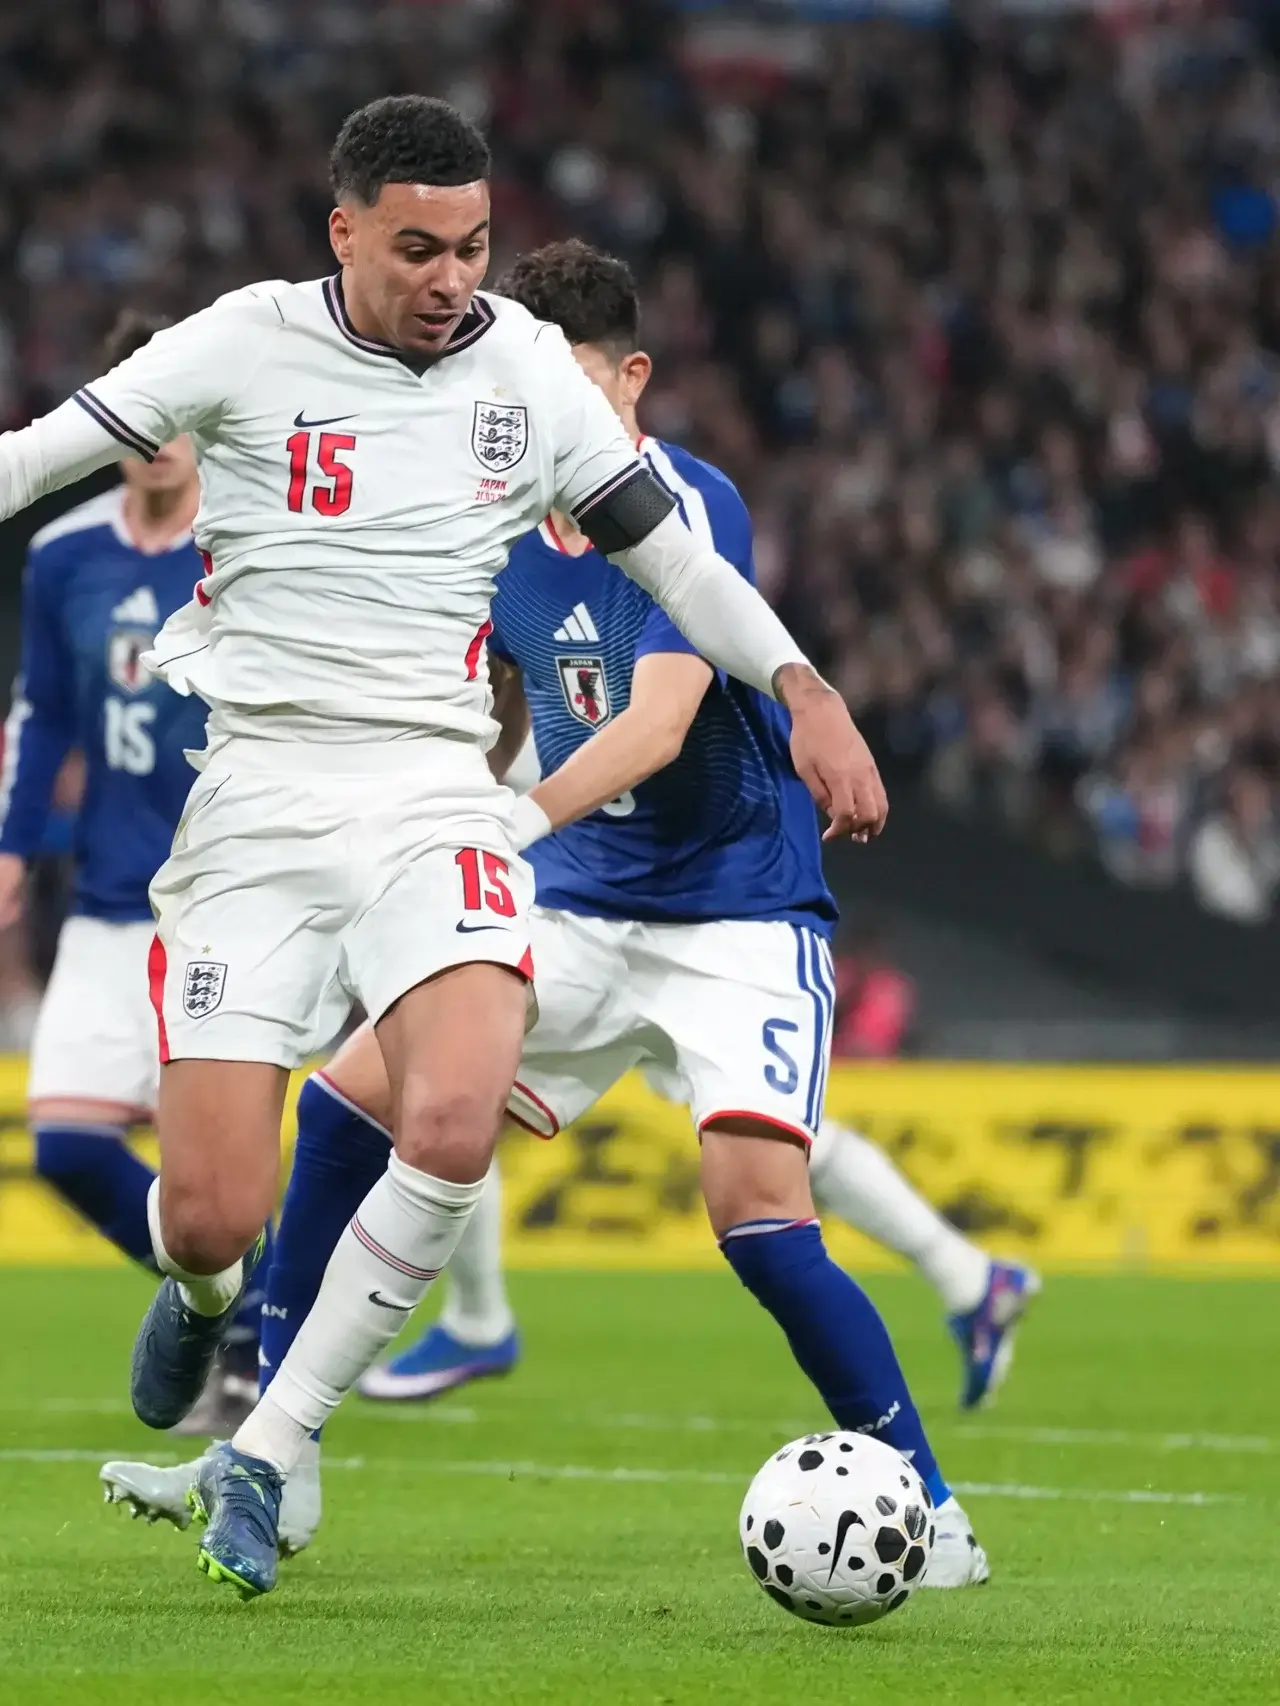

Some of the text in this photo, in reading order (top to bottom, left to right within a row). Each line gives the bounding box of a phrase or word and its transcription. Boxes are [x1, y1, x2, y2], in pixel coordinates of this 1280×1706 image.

[286, 431, 356, 516] 15
[479, 478, 508, 491] JAPAN
[569, 659, 594, 667] JAPAN
[104, 695, 157, 776] 15
[455, 847, 517, 918] 15
[762, 1018, 799, 1095] 5
